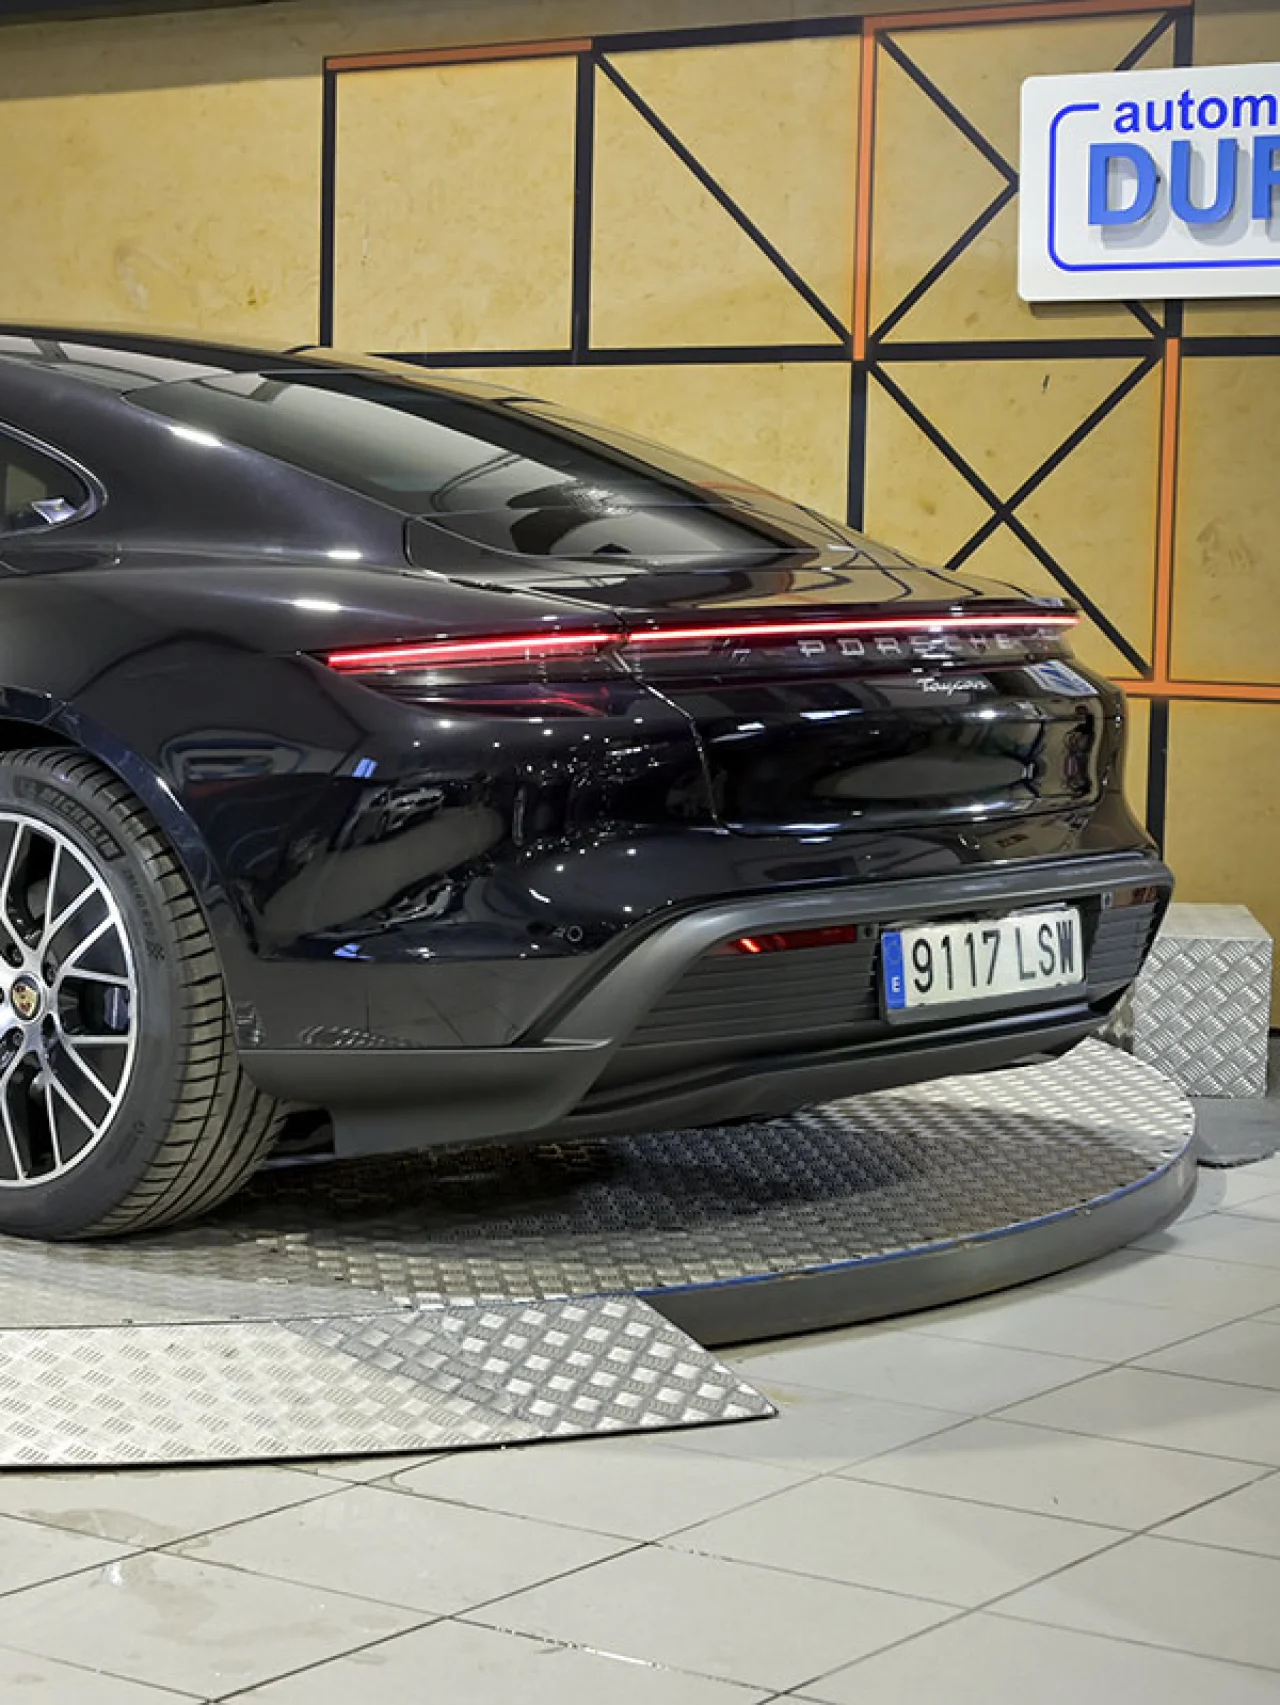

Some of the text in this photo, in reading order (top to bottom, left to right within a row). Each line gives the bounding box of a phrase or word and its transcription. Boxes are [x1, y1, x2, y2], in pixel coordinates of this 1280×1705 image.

[1113, 89, 1278, 133] autom
[917, 675, 989, 697] Taycan
[912, 919, 1074, 994] 9117 LSW
[891, 975, 902, 993] E
